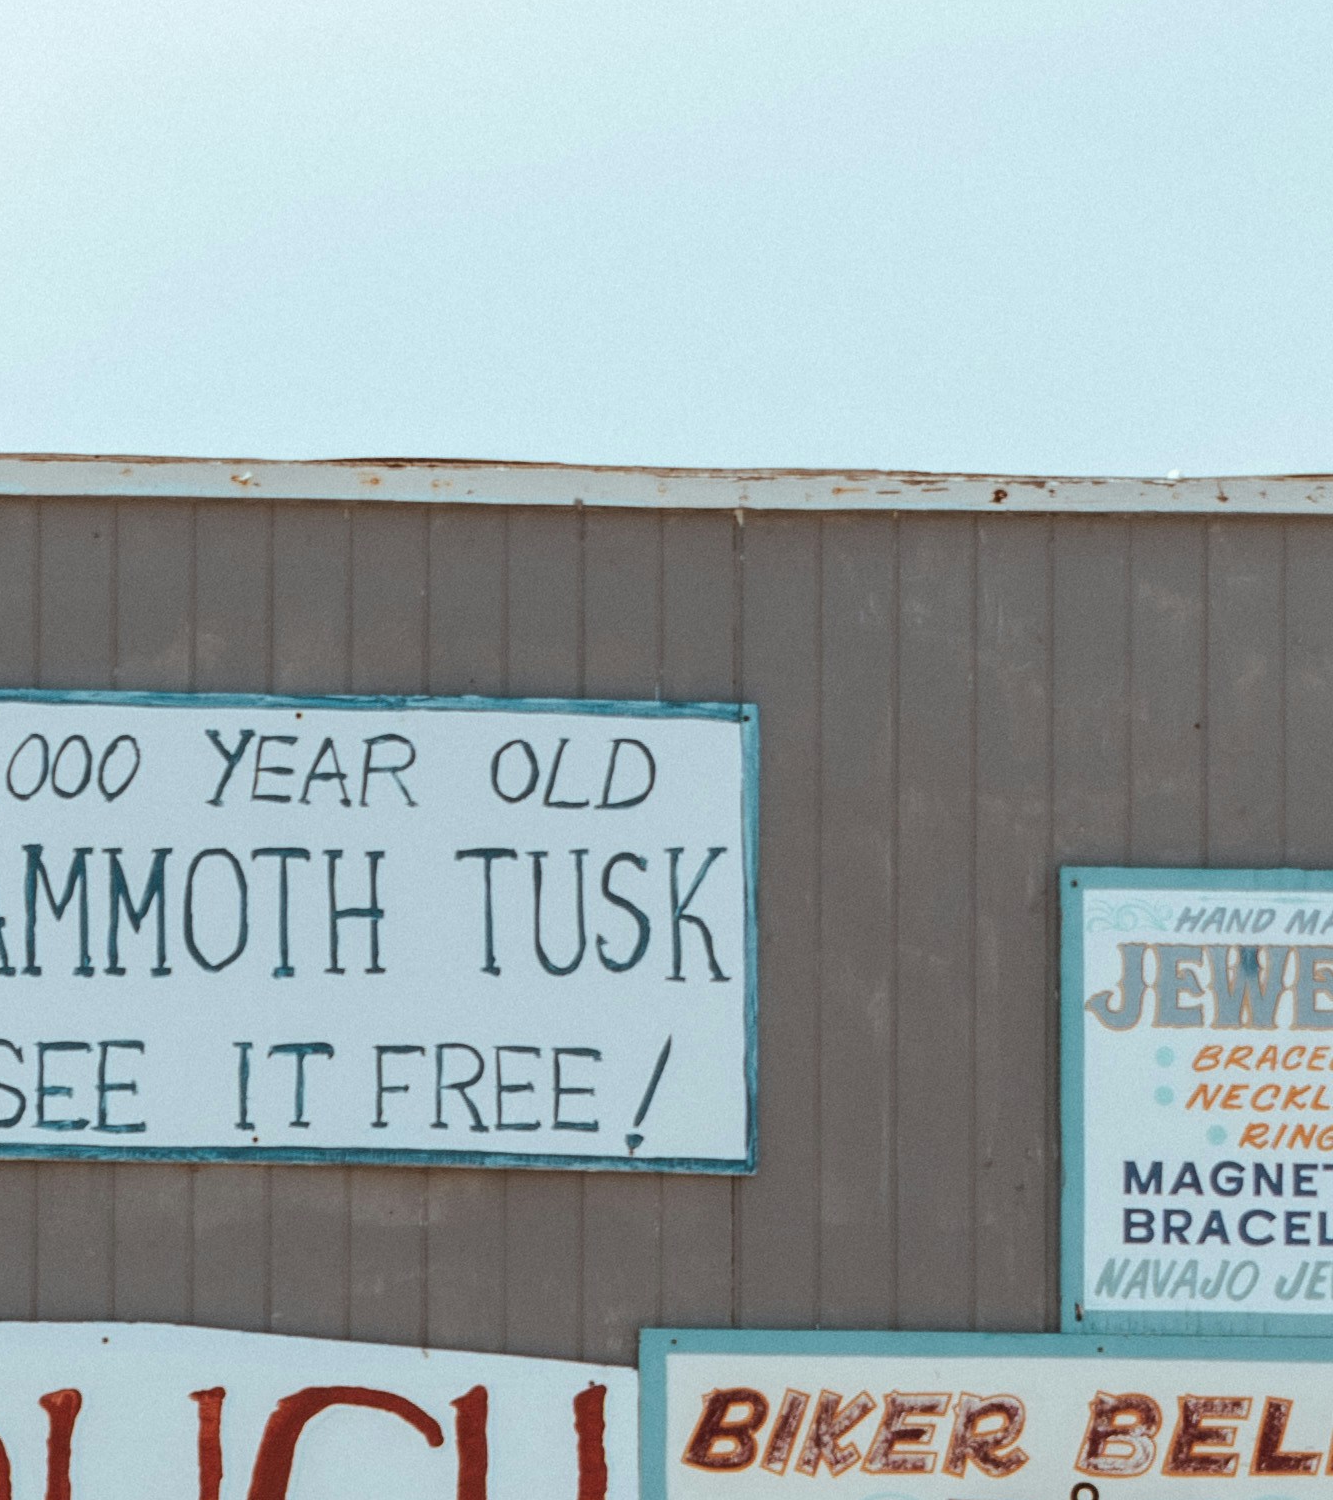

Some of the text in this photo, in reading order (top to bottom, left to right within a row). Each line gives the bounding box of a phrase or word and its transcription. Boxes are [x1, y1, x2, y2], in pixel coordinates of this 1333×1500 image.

[204, 729, 420, 810] YEAR
[490, 737, 658, 811] OLD
[454, 846, 731, 983] TUSK
[1174, 906, 1276, 935] HAND
[1191, 1044, 1333, 1072] BRACE
[232, 1041, 335, 1132] IT
[369, 1035, 673, 1156] FREE!
[1184, 1083, 1331, 1112] NECKL
[1238, 1122, 1333, 1151] RING
[1121, 1207, 1333, 1247] BRACEL
[1094, 1256, 1333, 1302] NAVAJO JE
[681, 1386, 1333, 1479] BIKER BEL
